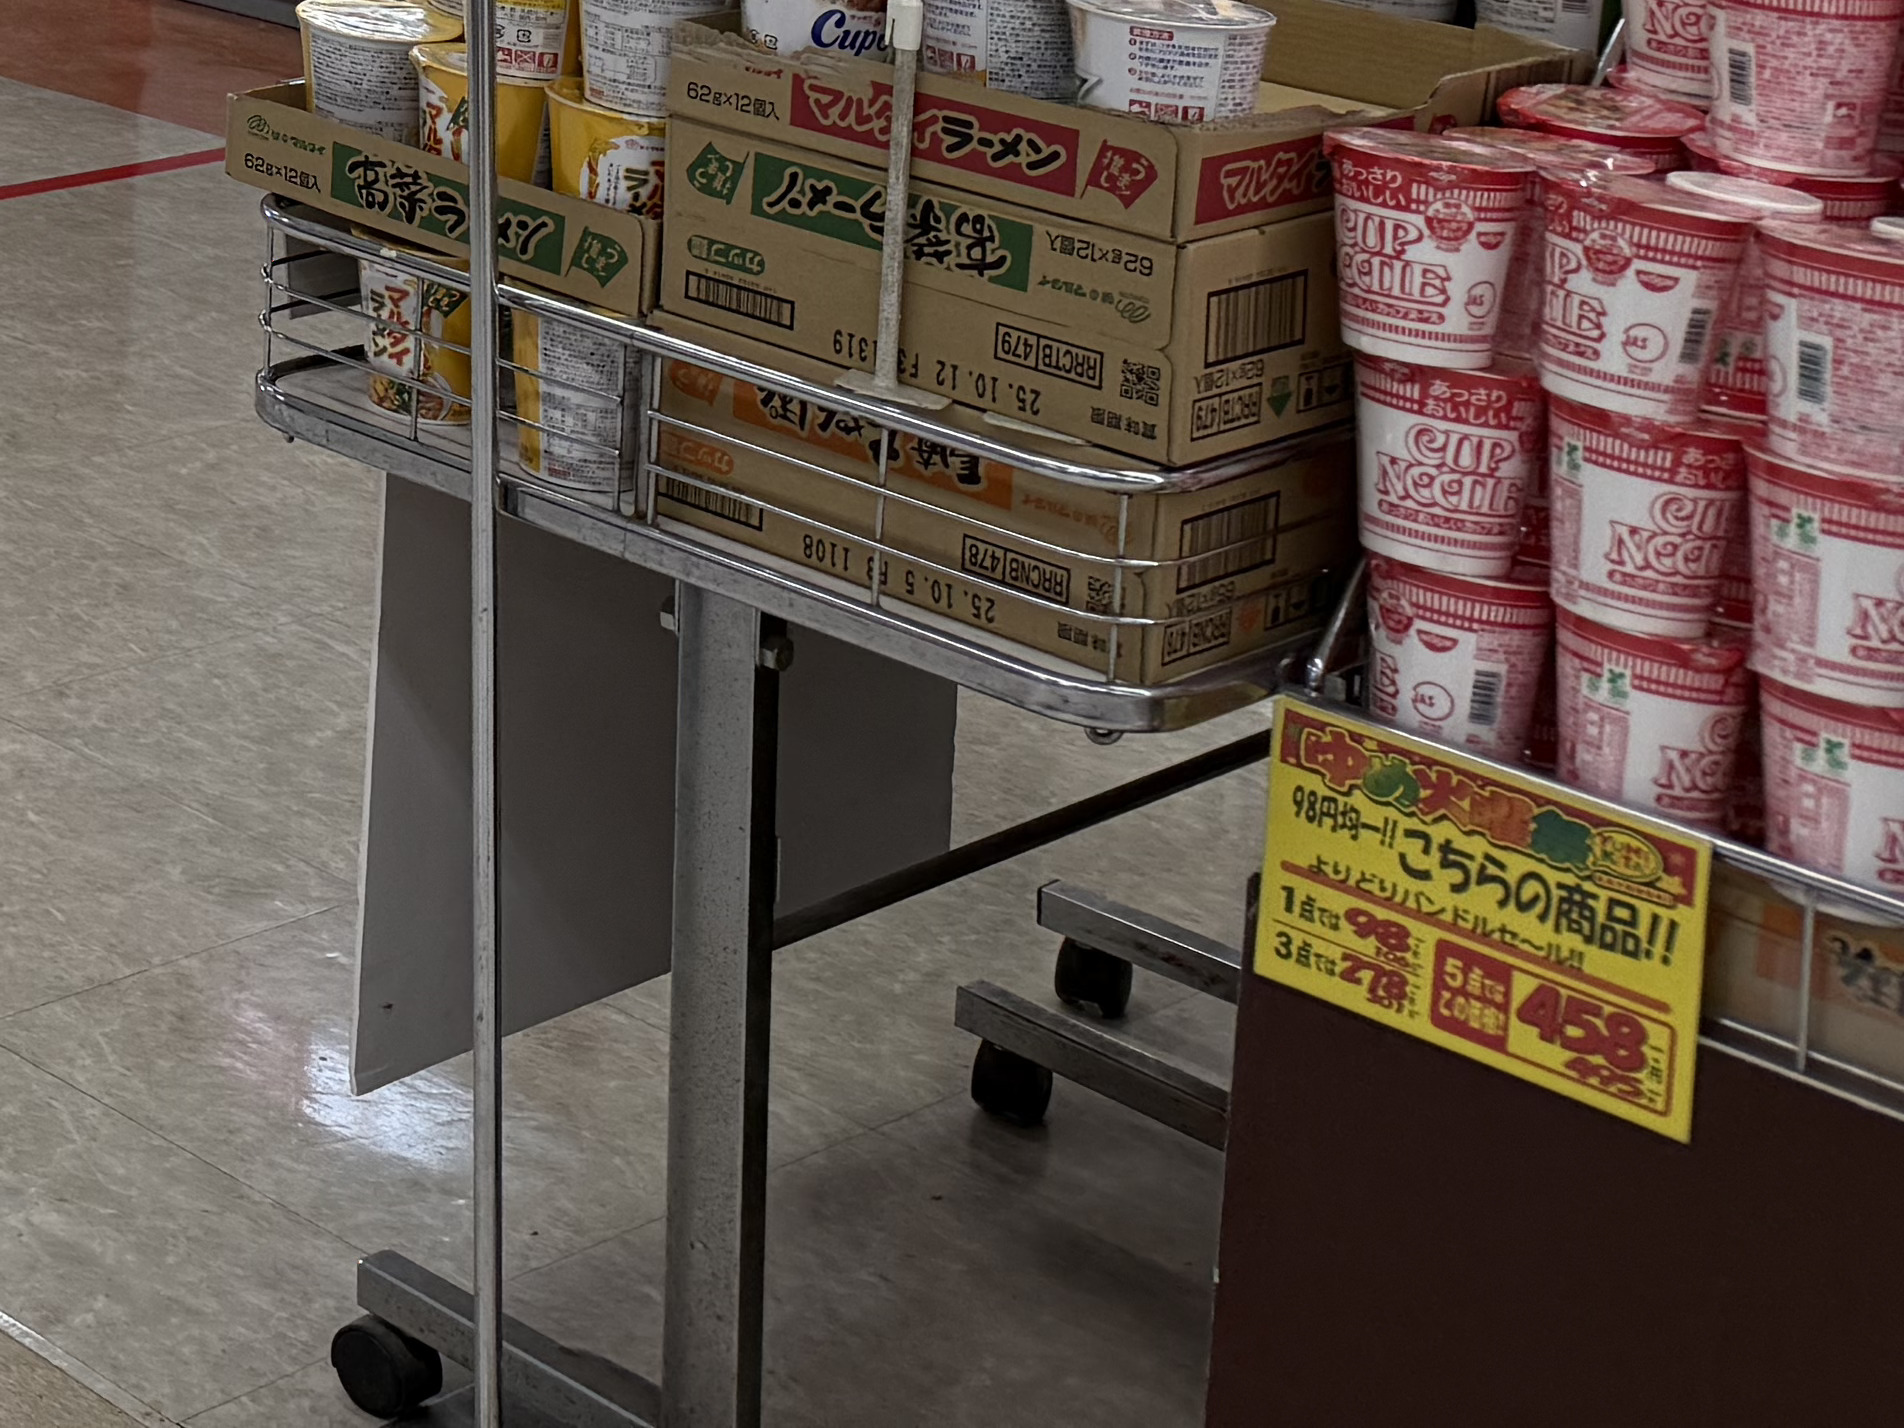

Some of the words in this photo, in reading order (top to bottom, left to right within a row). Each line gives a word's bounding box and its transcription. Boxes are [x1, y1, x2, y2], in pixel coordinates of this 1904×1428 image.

[1341, 158, 1403, 189] あっさり
[1339, 204, 1424, 260] CUP
[998, 328, 1035, 362] 479
[1039, 342, 1102, 384] RRCTB
[1423, 398, 1509, 426] おいしい
[1428, 378, 1508, 408] あっさり
[1090, 406, 1159, 441] 賞味期限
[1405, 422, 1516, 475] CUP
[1291, 785, 1394, 850] 98円均一!!
[1398, 827, 1680, 967] こちらの商品!!
[1279, 886, 1342, 932] 1点では
[1343, 907, 1412, 954] 98
[1274, 931, 1339, 977] 3点では
[1339, 952, 1409, 1004] 278
[1442, 956, 1507, 1002] 5点では
[1516, 982, 1647, 1074] 458
